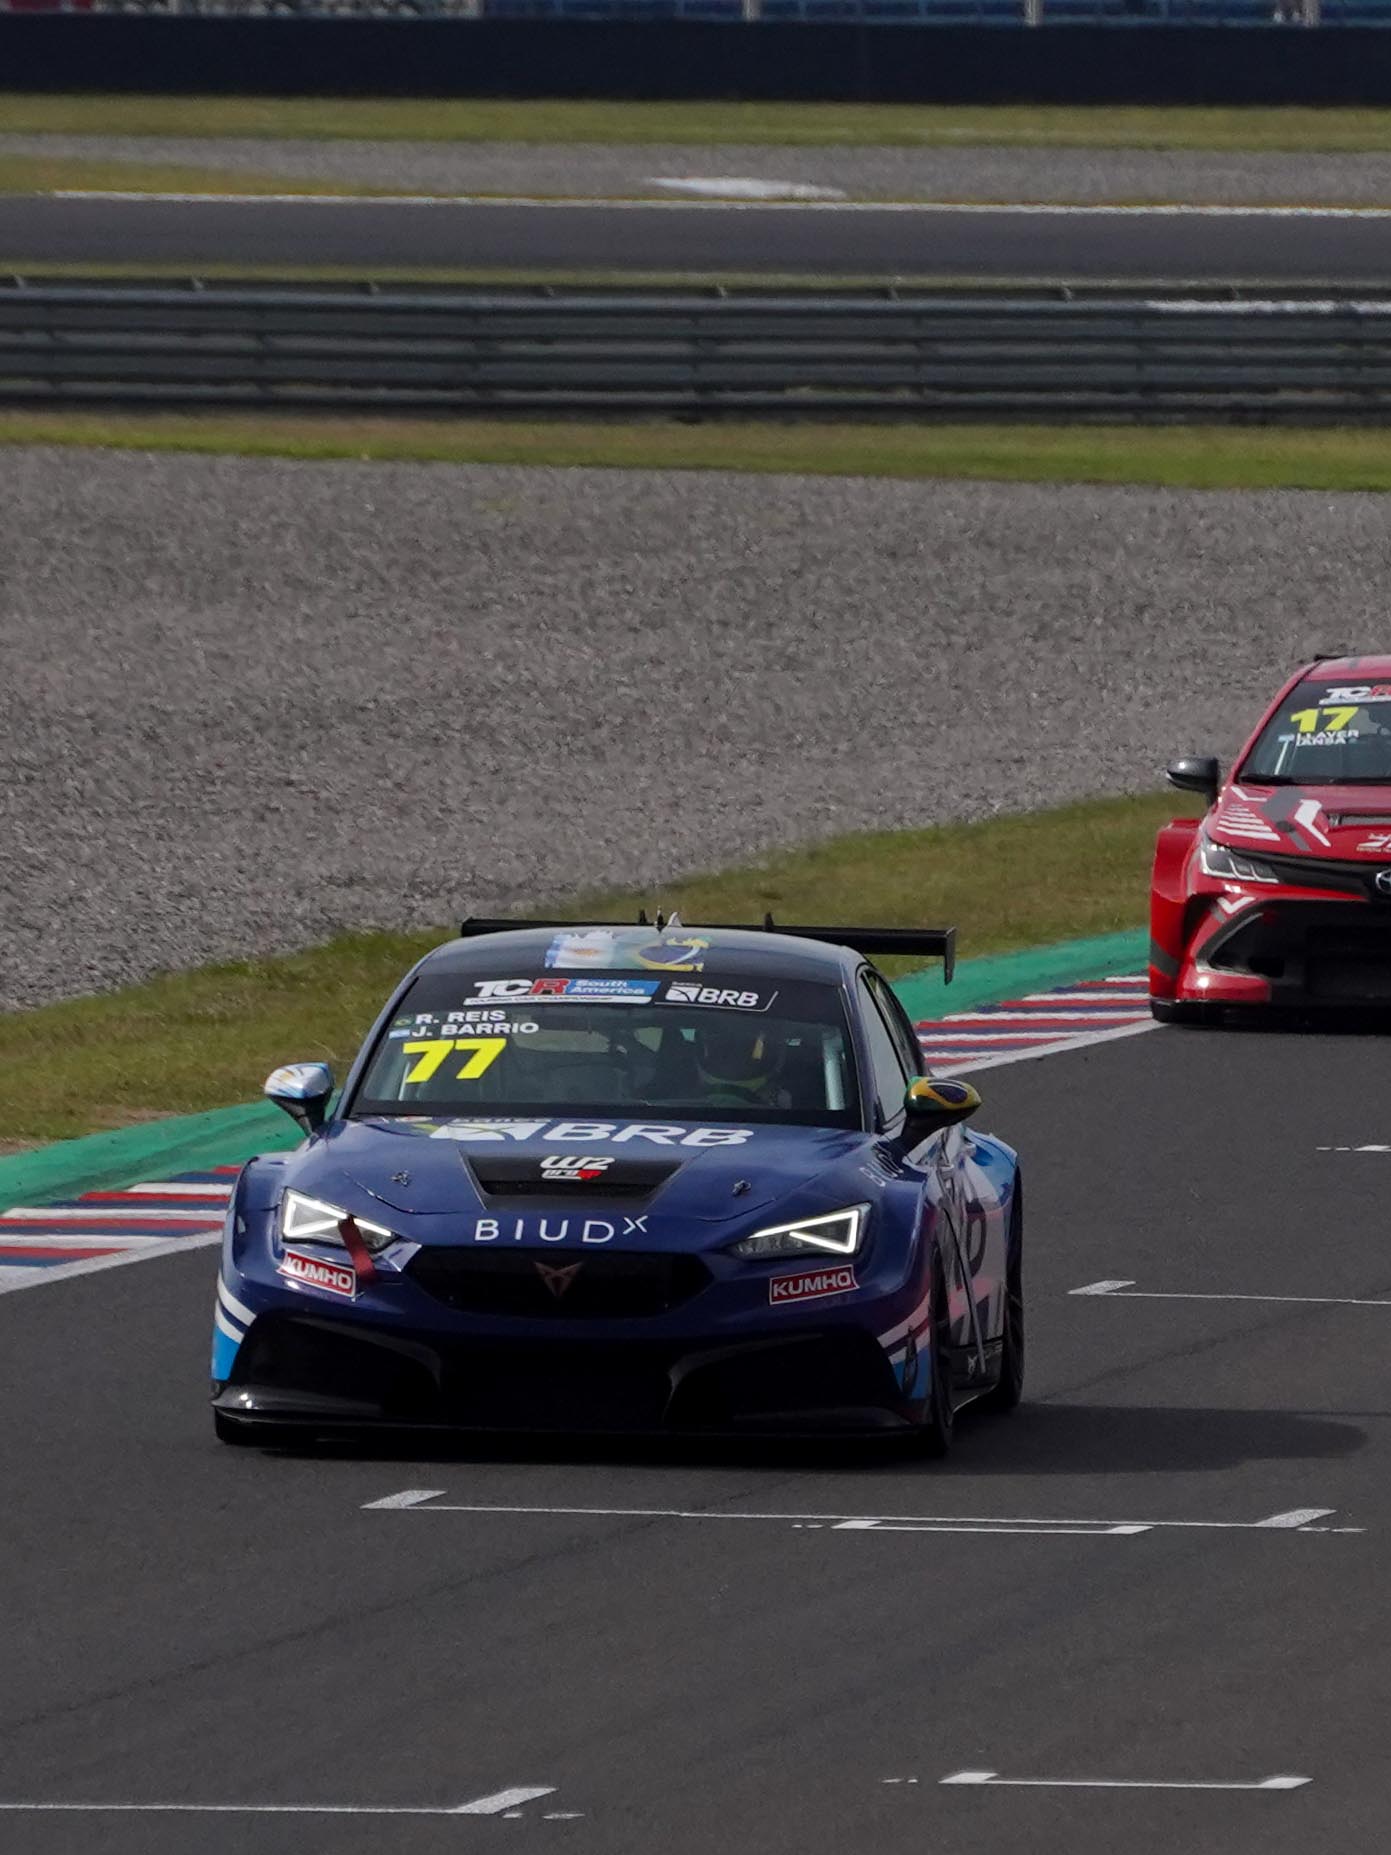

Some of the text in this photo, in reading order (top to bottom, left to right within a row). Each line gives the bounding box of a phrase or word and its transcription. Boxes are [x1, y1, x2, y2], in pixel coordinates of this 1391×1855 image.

[1290, 706, 1360, 733] 17
[473, 978, 570, 998] TCR
[571, 986, 645, 995] America
[576, 978, 628, 987] South
[698, 988, 759, 1007] BRB
[415, 1010, 506, 1025] R. REIS
[411, 1023, 539, 1037] J. BARRIO
[402, 1037, 508, 1083] 77
[542, 1122, 754, 1146] BRB
[539, 1155, 615, 1171] W2
[283, 1255, 353, 1288] KUMHO
[772, 1271, 852, 1298] KUMHO
